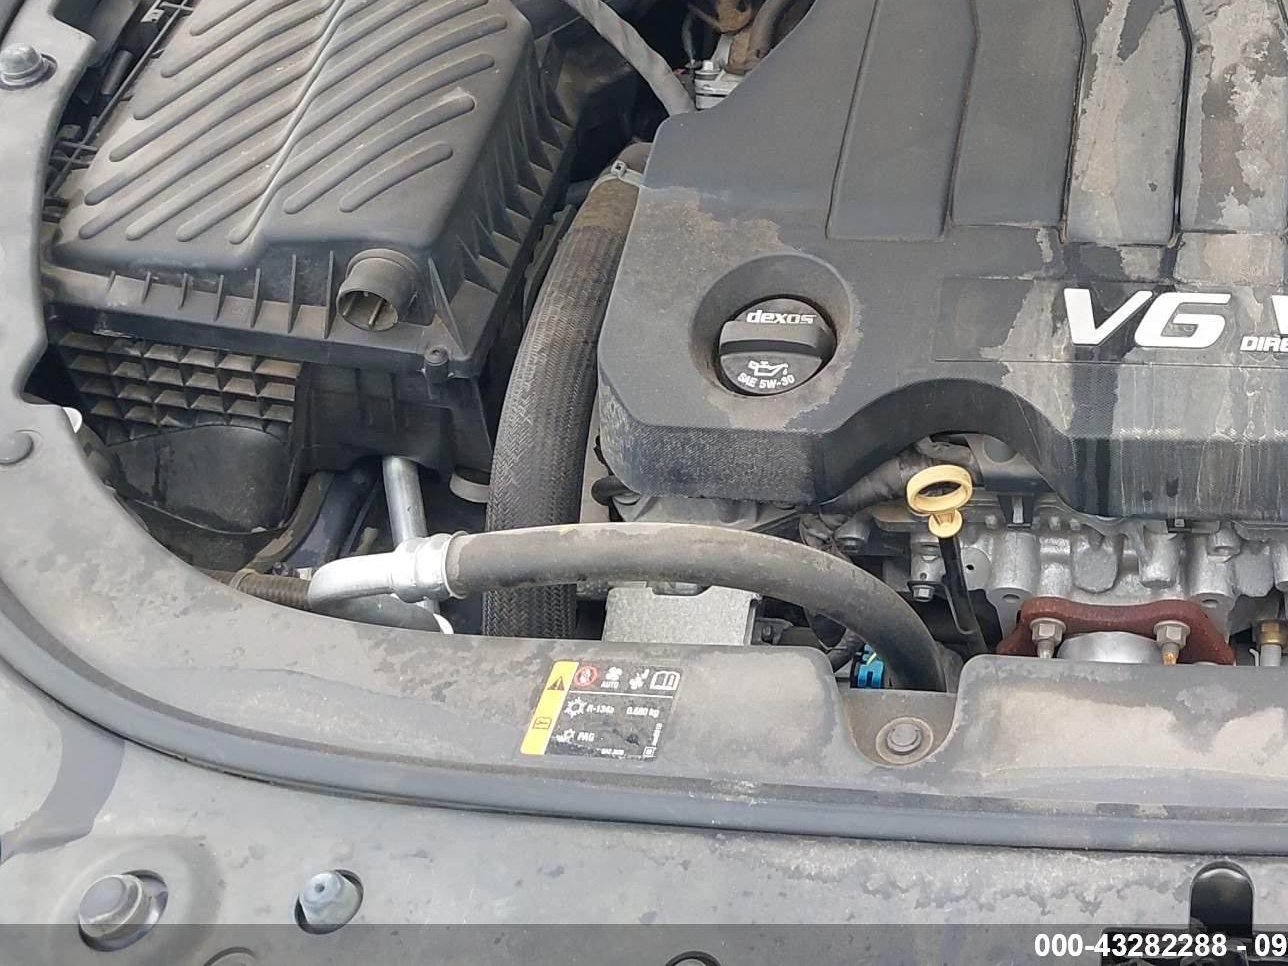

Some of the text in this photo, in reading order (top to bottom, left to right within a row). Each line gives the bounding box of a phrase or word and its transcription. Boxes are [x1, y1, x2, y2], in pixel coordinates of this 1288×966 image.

[746, 309, 817, 325] dexos
[1063, 287, 1232, 349] V6
[737, 372, 796, 389] SAE 5W-30
[600, 680, 620, 690] AUTO
[577, 732, 596, 743] PAG
